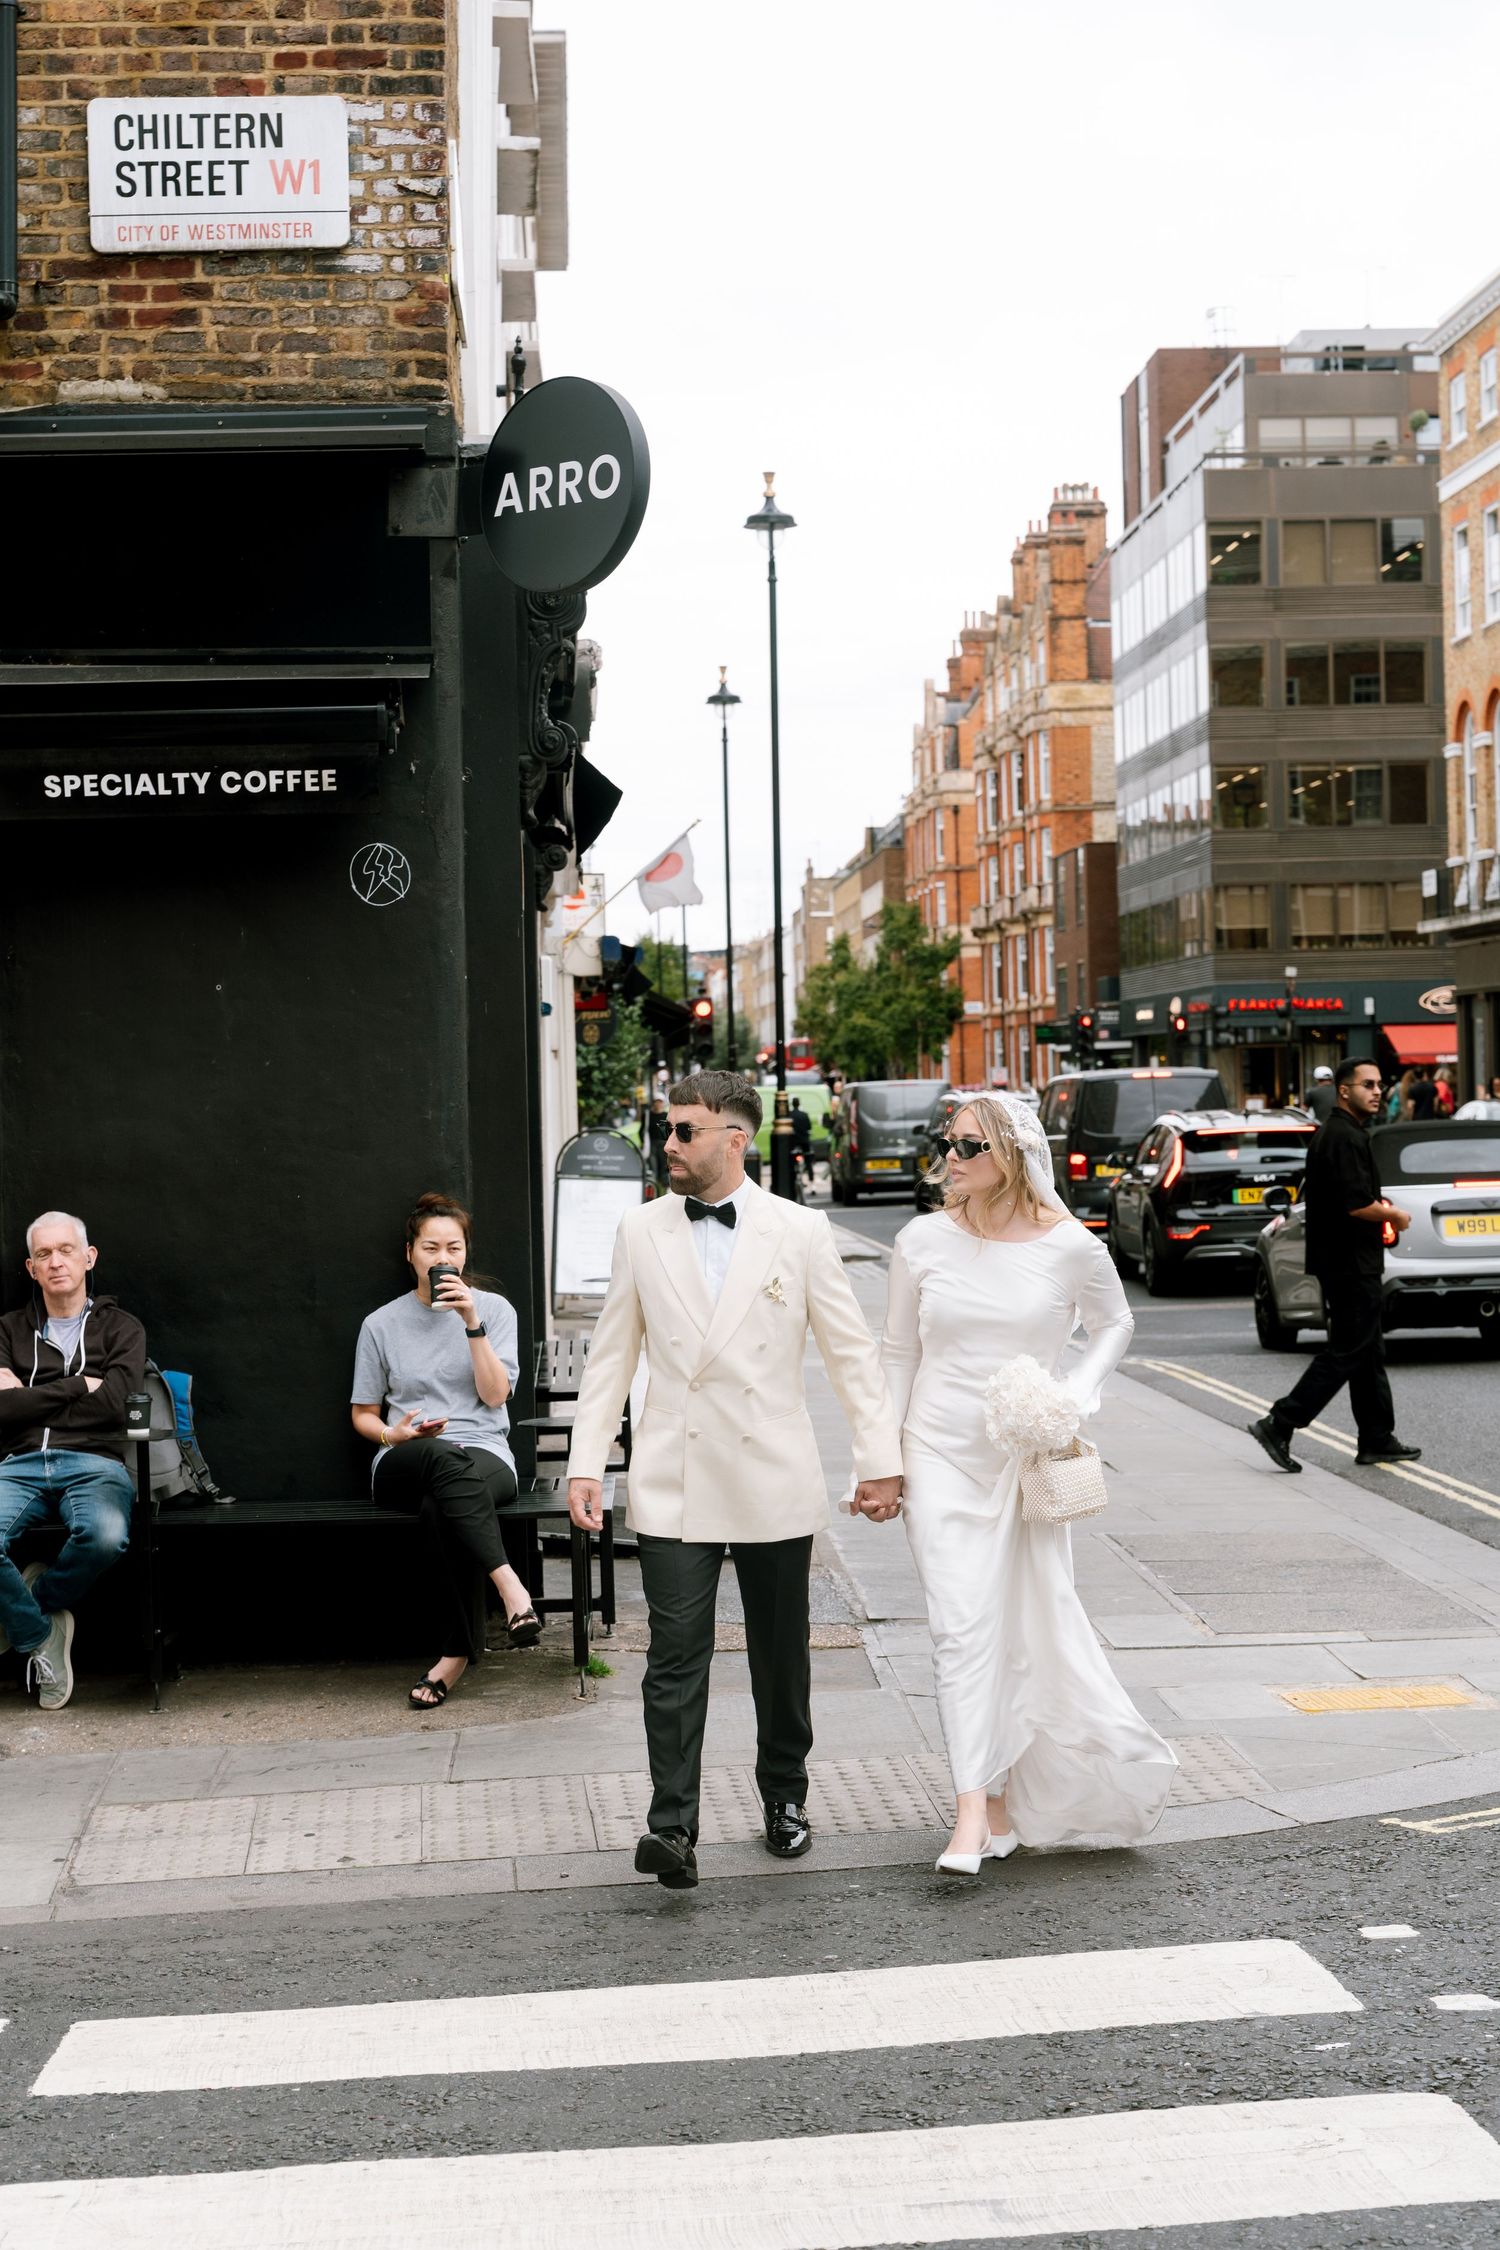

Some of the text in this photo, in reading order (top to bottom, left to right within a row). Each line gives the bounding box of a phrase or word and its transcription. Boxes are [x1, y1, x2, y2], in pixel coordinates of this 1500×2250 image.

[113, 112, 284, 151] CHILTERN
[115, 158, 321, 198] STREET W1
[117, 222, 313, 242] CITY OF WESTMINSTER
[493, 453, 621, 518] ARRO
[43, 769, 338, 798] SPECIALTY COFFEE
[1240, 1190, 1263, 1201] EN7
[1456, 1218, 1487, 1233] W99
